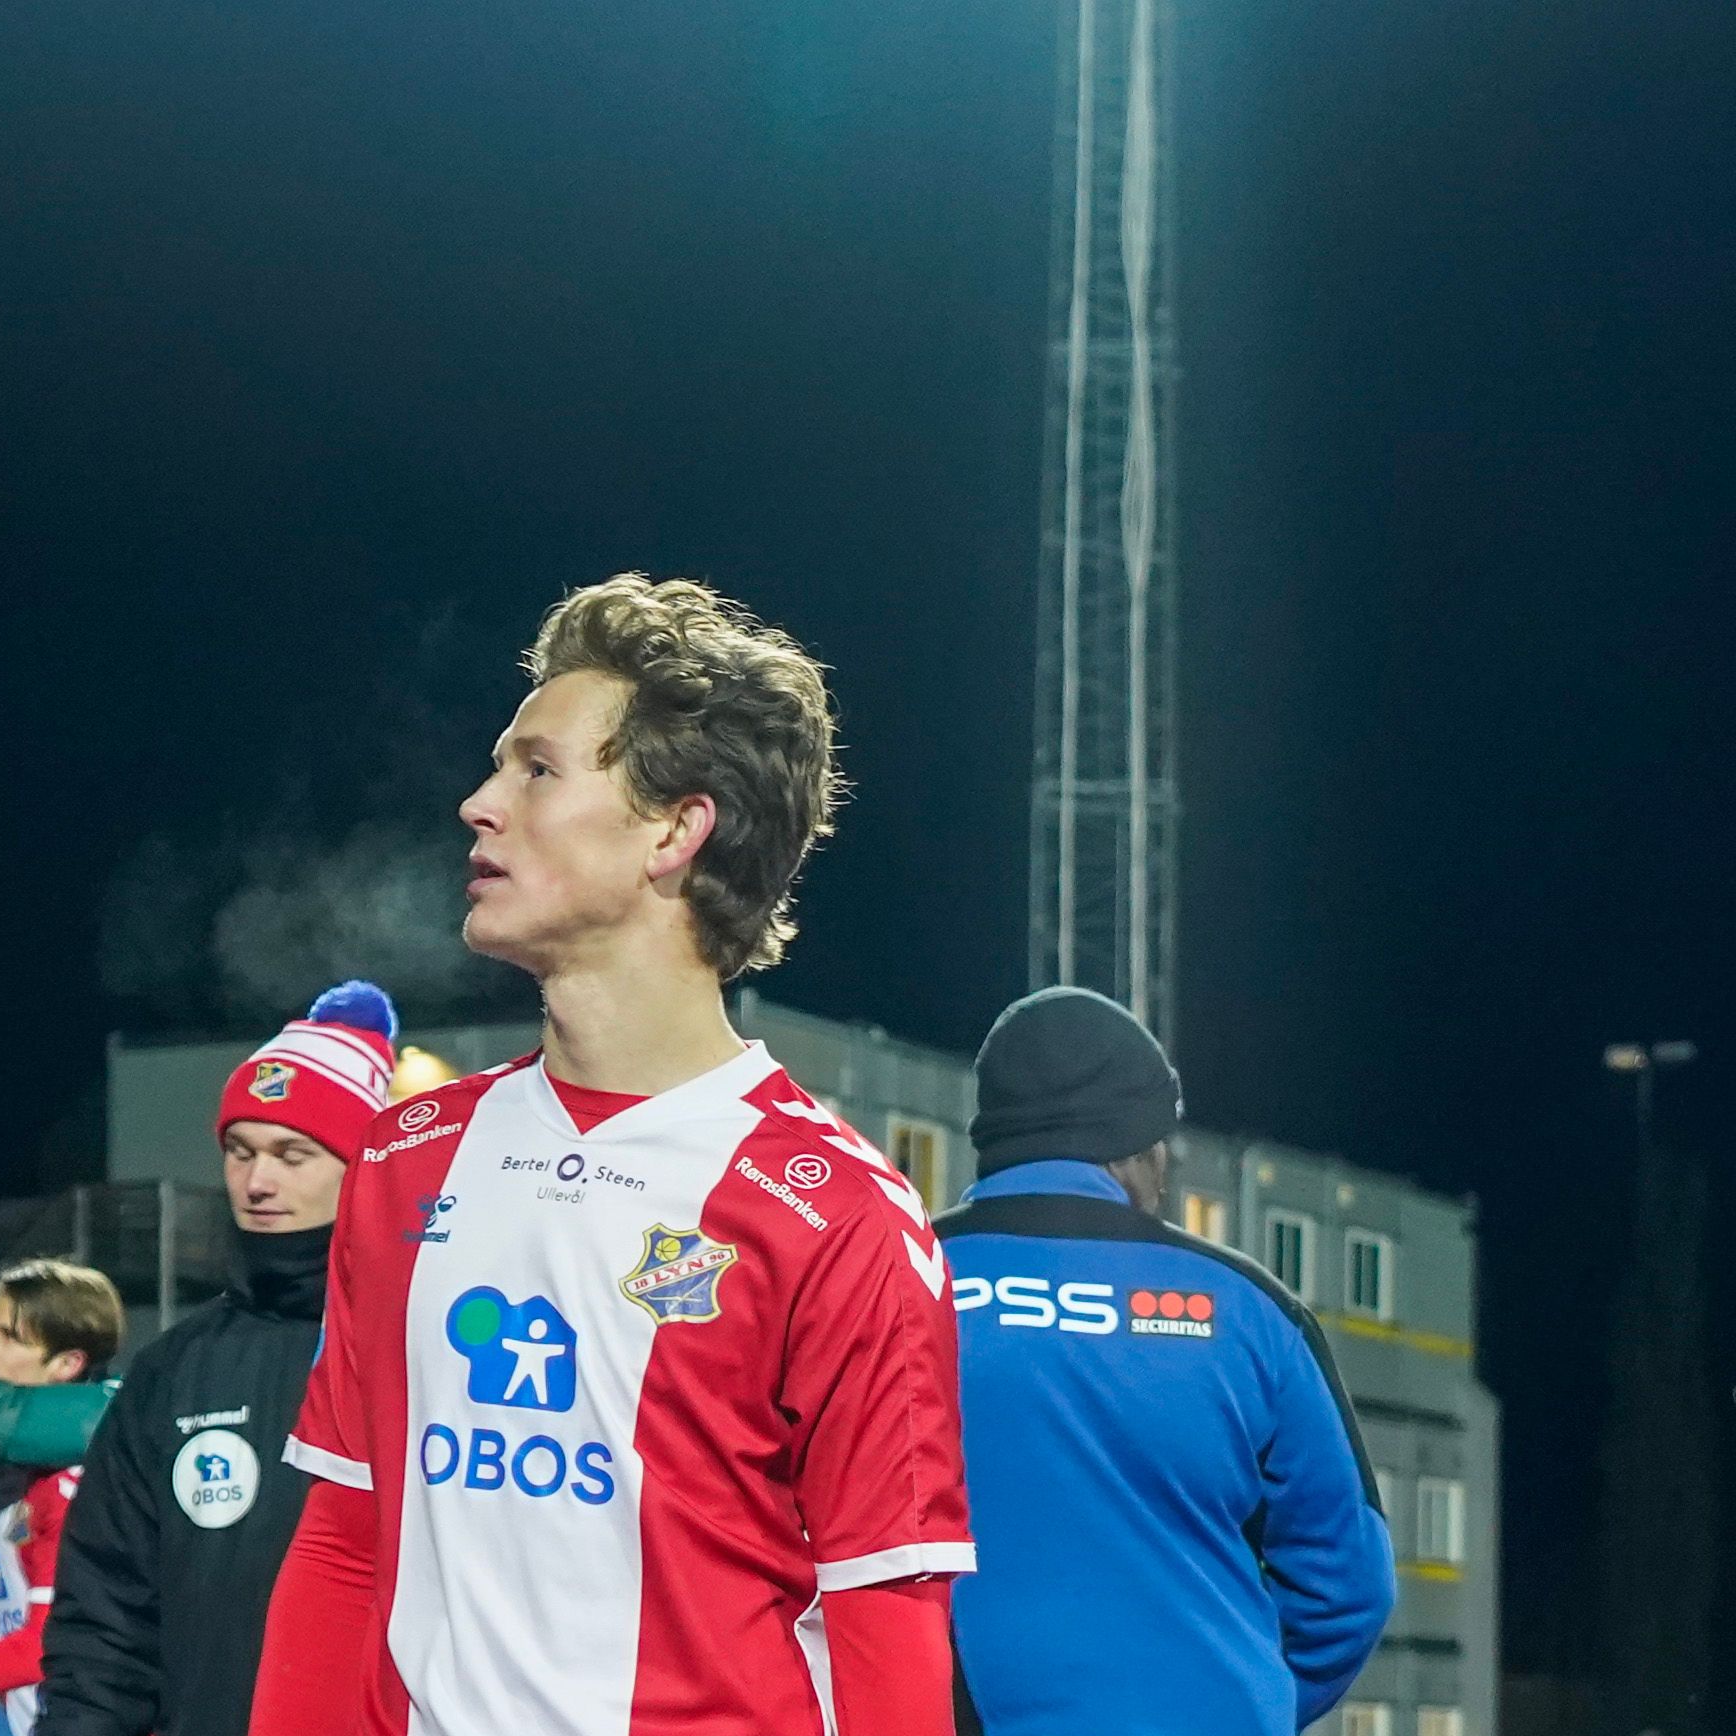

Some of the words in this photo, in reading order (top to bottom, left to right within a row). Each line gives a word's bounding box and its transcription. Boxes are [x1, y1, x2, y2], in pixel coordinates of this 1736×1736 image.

[501, 1156, 551, 1172] Bertel
[594, 1166, 646, 1191] Steen
[734, 1156, 829, 1232] RørosBanken
[653, 1257, 705, 1283] LYN
[1131, 1318, 1212, 1337] SECURITAS
[420, 1423, 615, 1506] OBOS
[192, 1485, 243, 1507] OBOS
